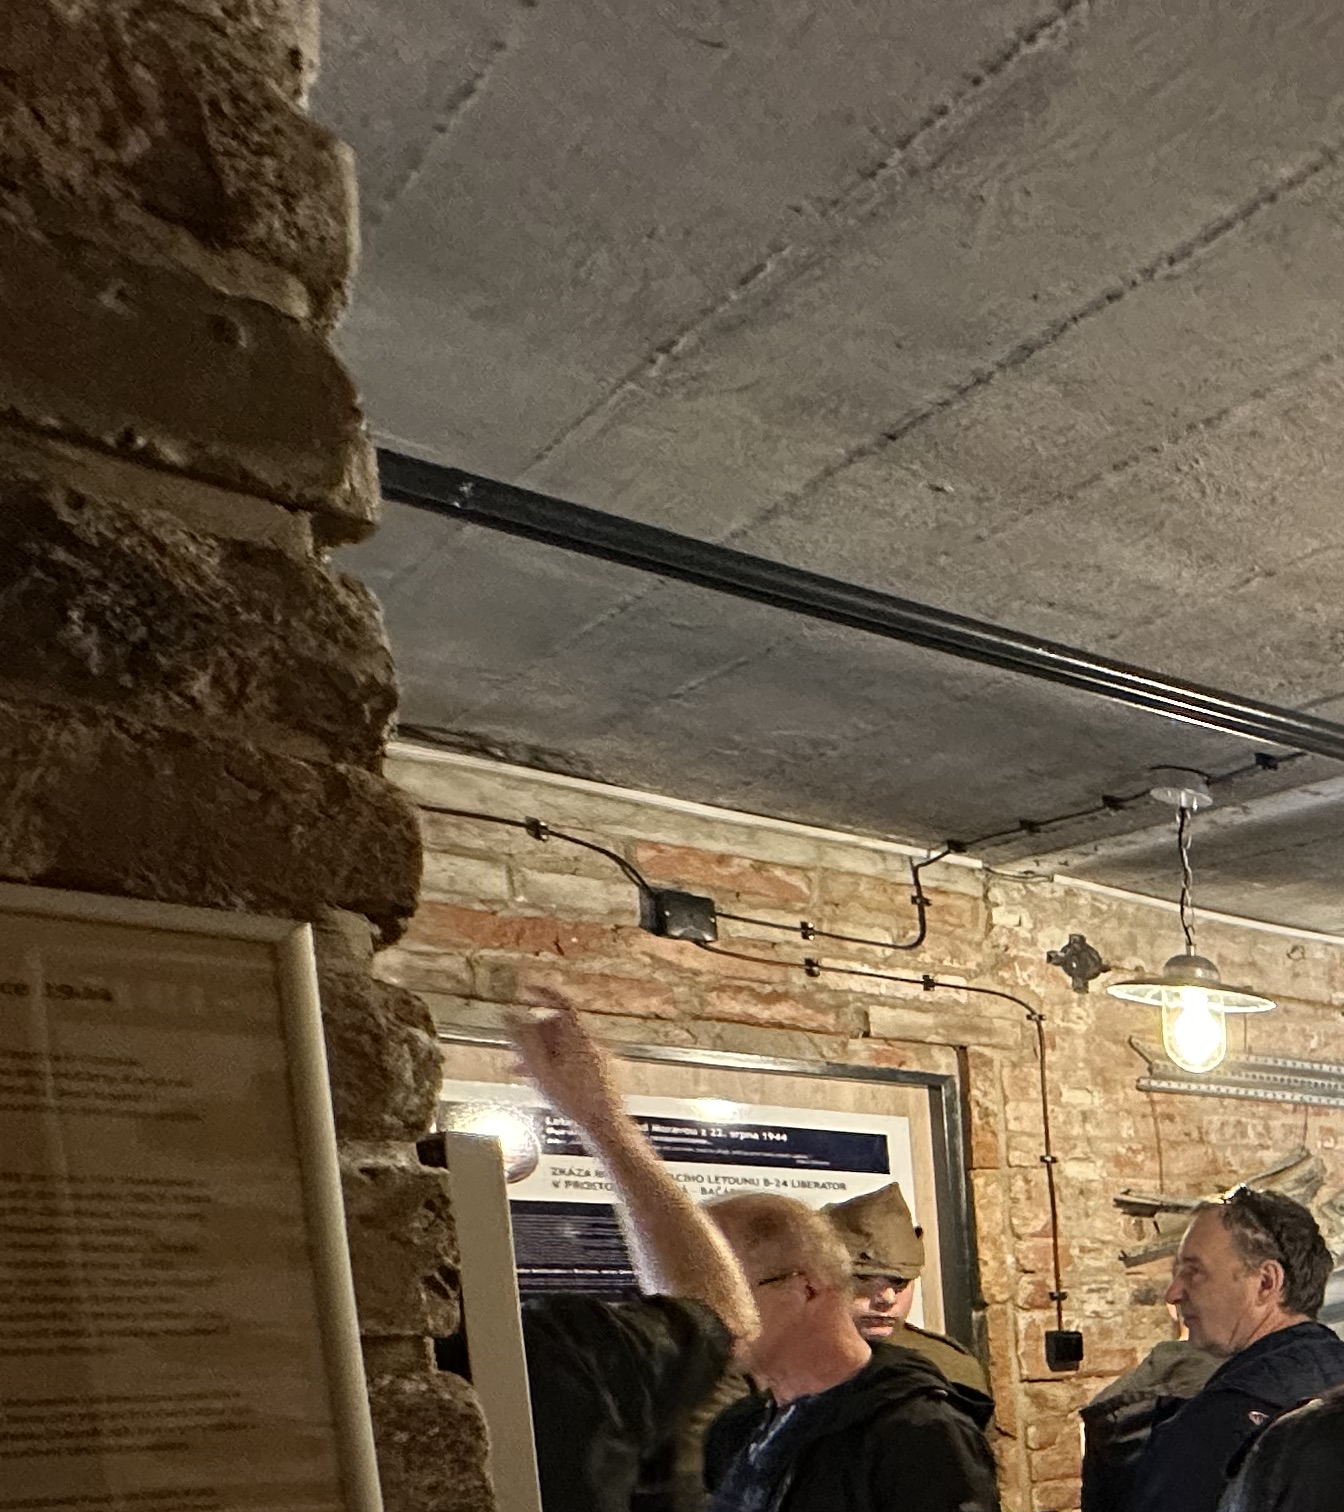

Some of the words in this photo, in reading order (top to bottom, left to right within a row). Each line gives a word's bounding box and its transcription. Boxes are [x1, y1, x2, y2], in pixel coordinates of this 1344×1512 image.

[761, 1132, 788, 1142] 1944
[550, 1166, 591, 1177] ZKÁZA
[707, 1175, 759, 1186] LETOUNU
[763, 1178, 788, 1188] B-24
[791, 1178, 847, 1190] LIBERATOR
